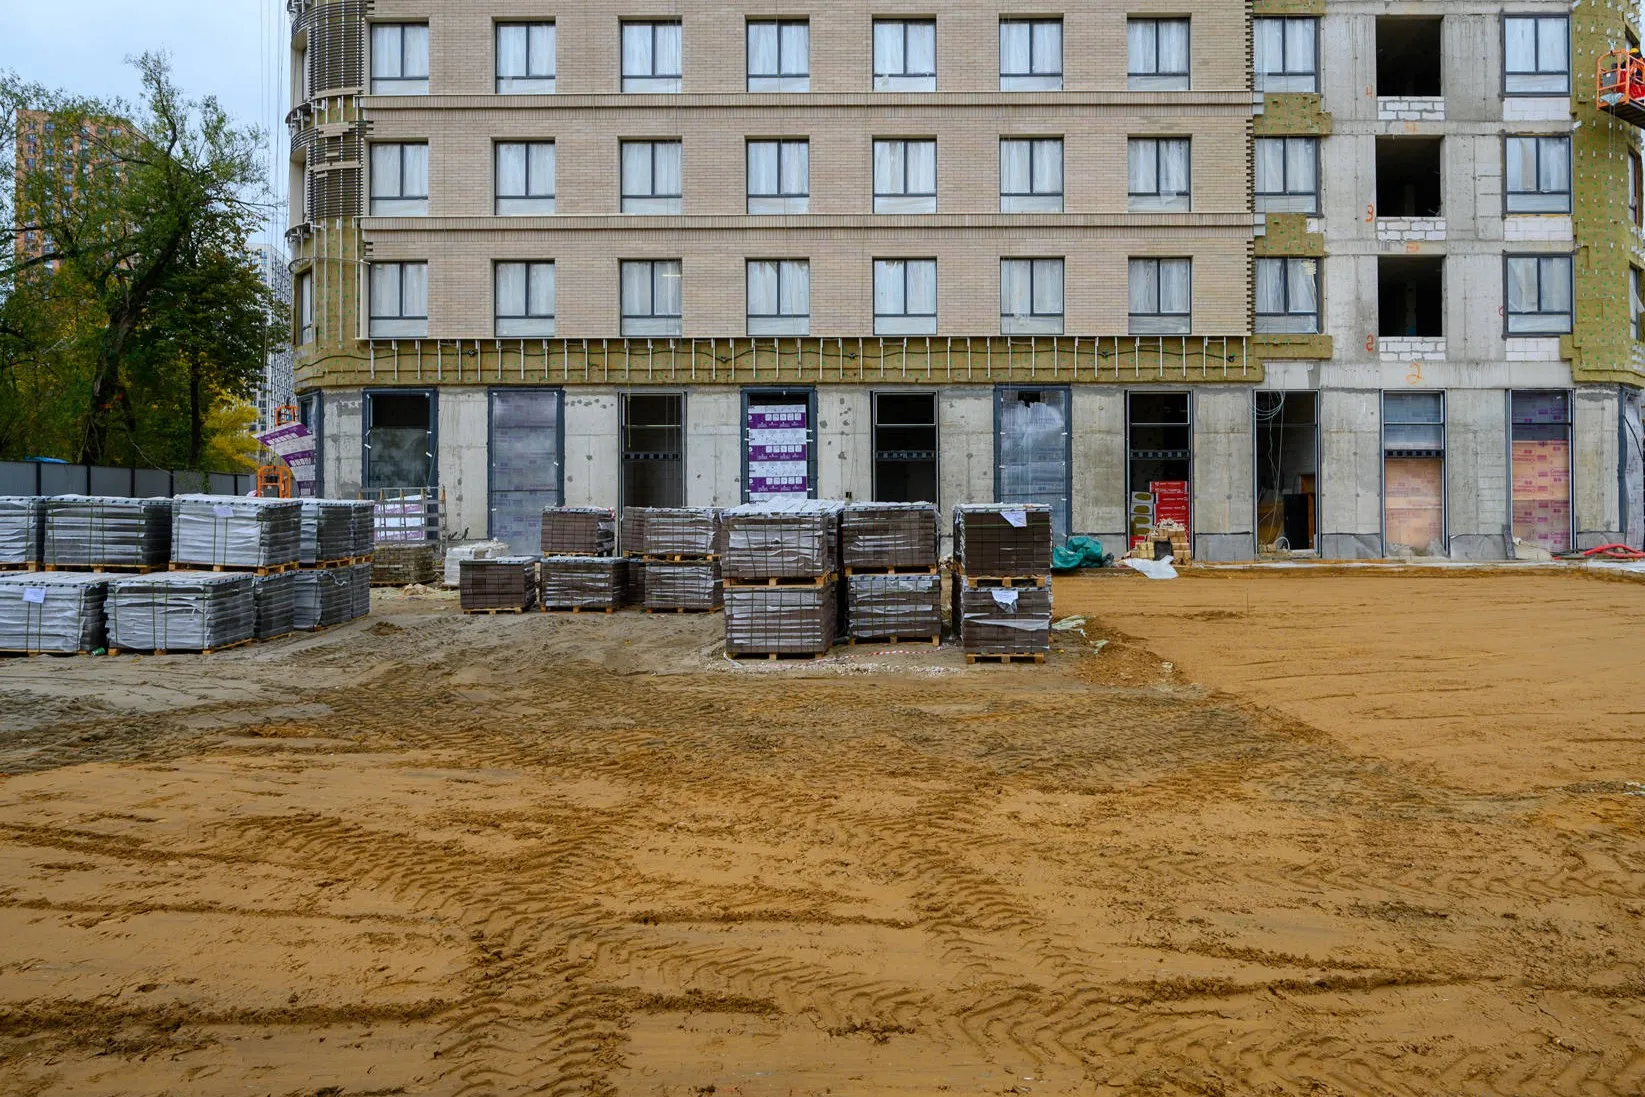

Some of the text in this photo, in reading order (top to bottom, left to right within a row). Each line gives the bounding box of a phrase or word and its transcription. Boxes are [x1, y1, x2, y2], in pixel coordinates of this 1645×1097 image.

[1365, 203, 1374, 222] 3
[1365, 334, 1374, 352] 2
[1405, 361, 1425, 385] 2
